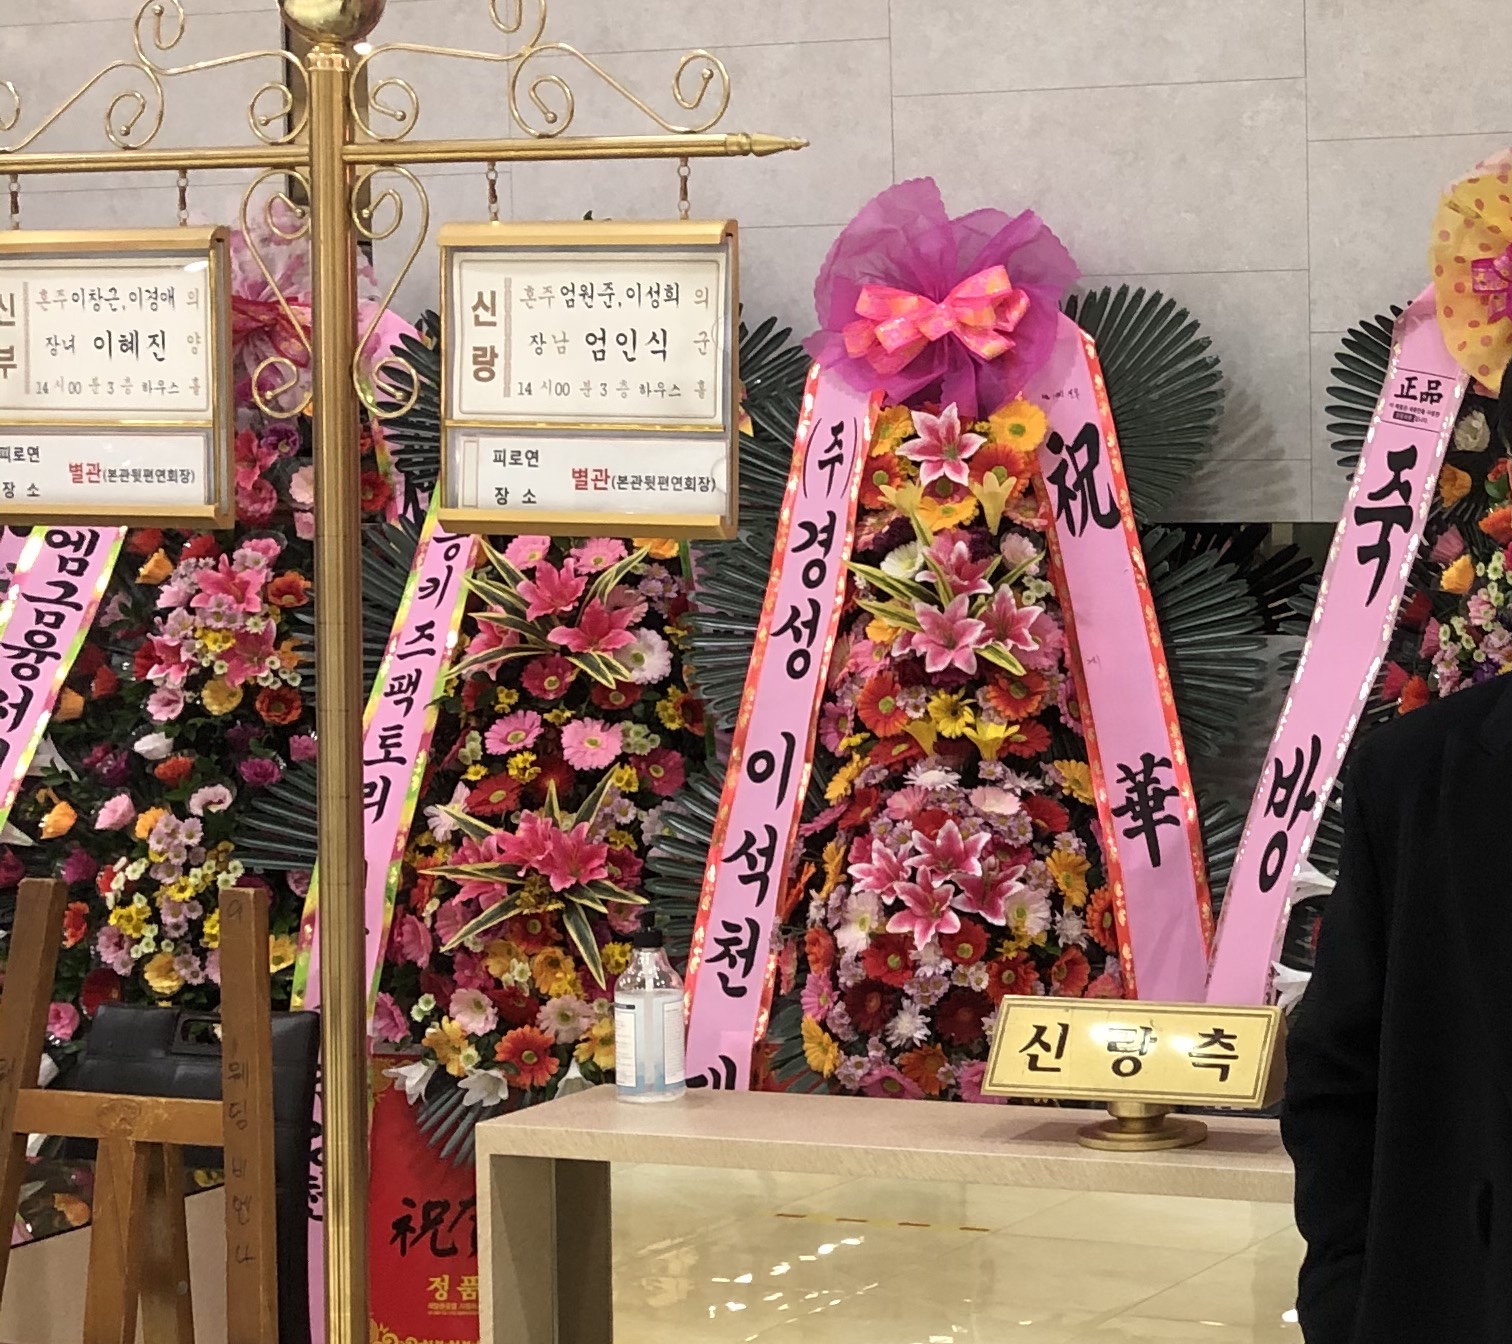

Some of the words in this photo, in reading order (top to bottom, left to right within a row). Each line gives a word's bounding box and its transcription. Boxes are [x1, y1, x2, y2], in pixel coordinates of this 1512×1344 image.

[186, 288, 199, 309] 의
[519, 285, 555, 309] 혼주
[694, 287, 709, 310] 의
[46, 335, 76, 356] 장녀
[94, 330, 166, 362] 이혜진
[187, 332, 201, 355] 양
[471, 289, 499, 383] 신랑
[530, 331, 570, 356] 장남
[585, 327, 668, 363] 엄인식
[693, 331, 710, 356] 군
[107, 381, 114, 395] 3
[600, 382, 608, 397] 3
[639, 380, 682, 397] 하우스
[1394, 376, 1443, 405] 正品
[492, 449, 540, 468] 피로연
[1048, 422, 1122, 538] 祝
[1112, 753, 1181, 869] 華
[705, 730, 799, 1000] 이석천
[1018, 1021, 1240, 1084] 신랑측
